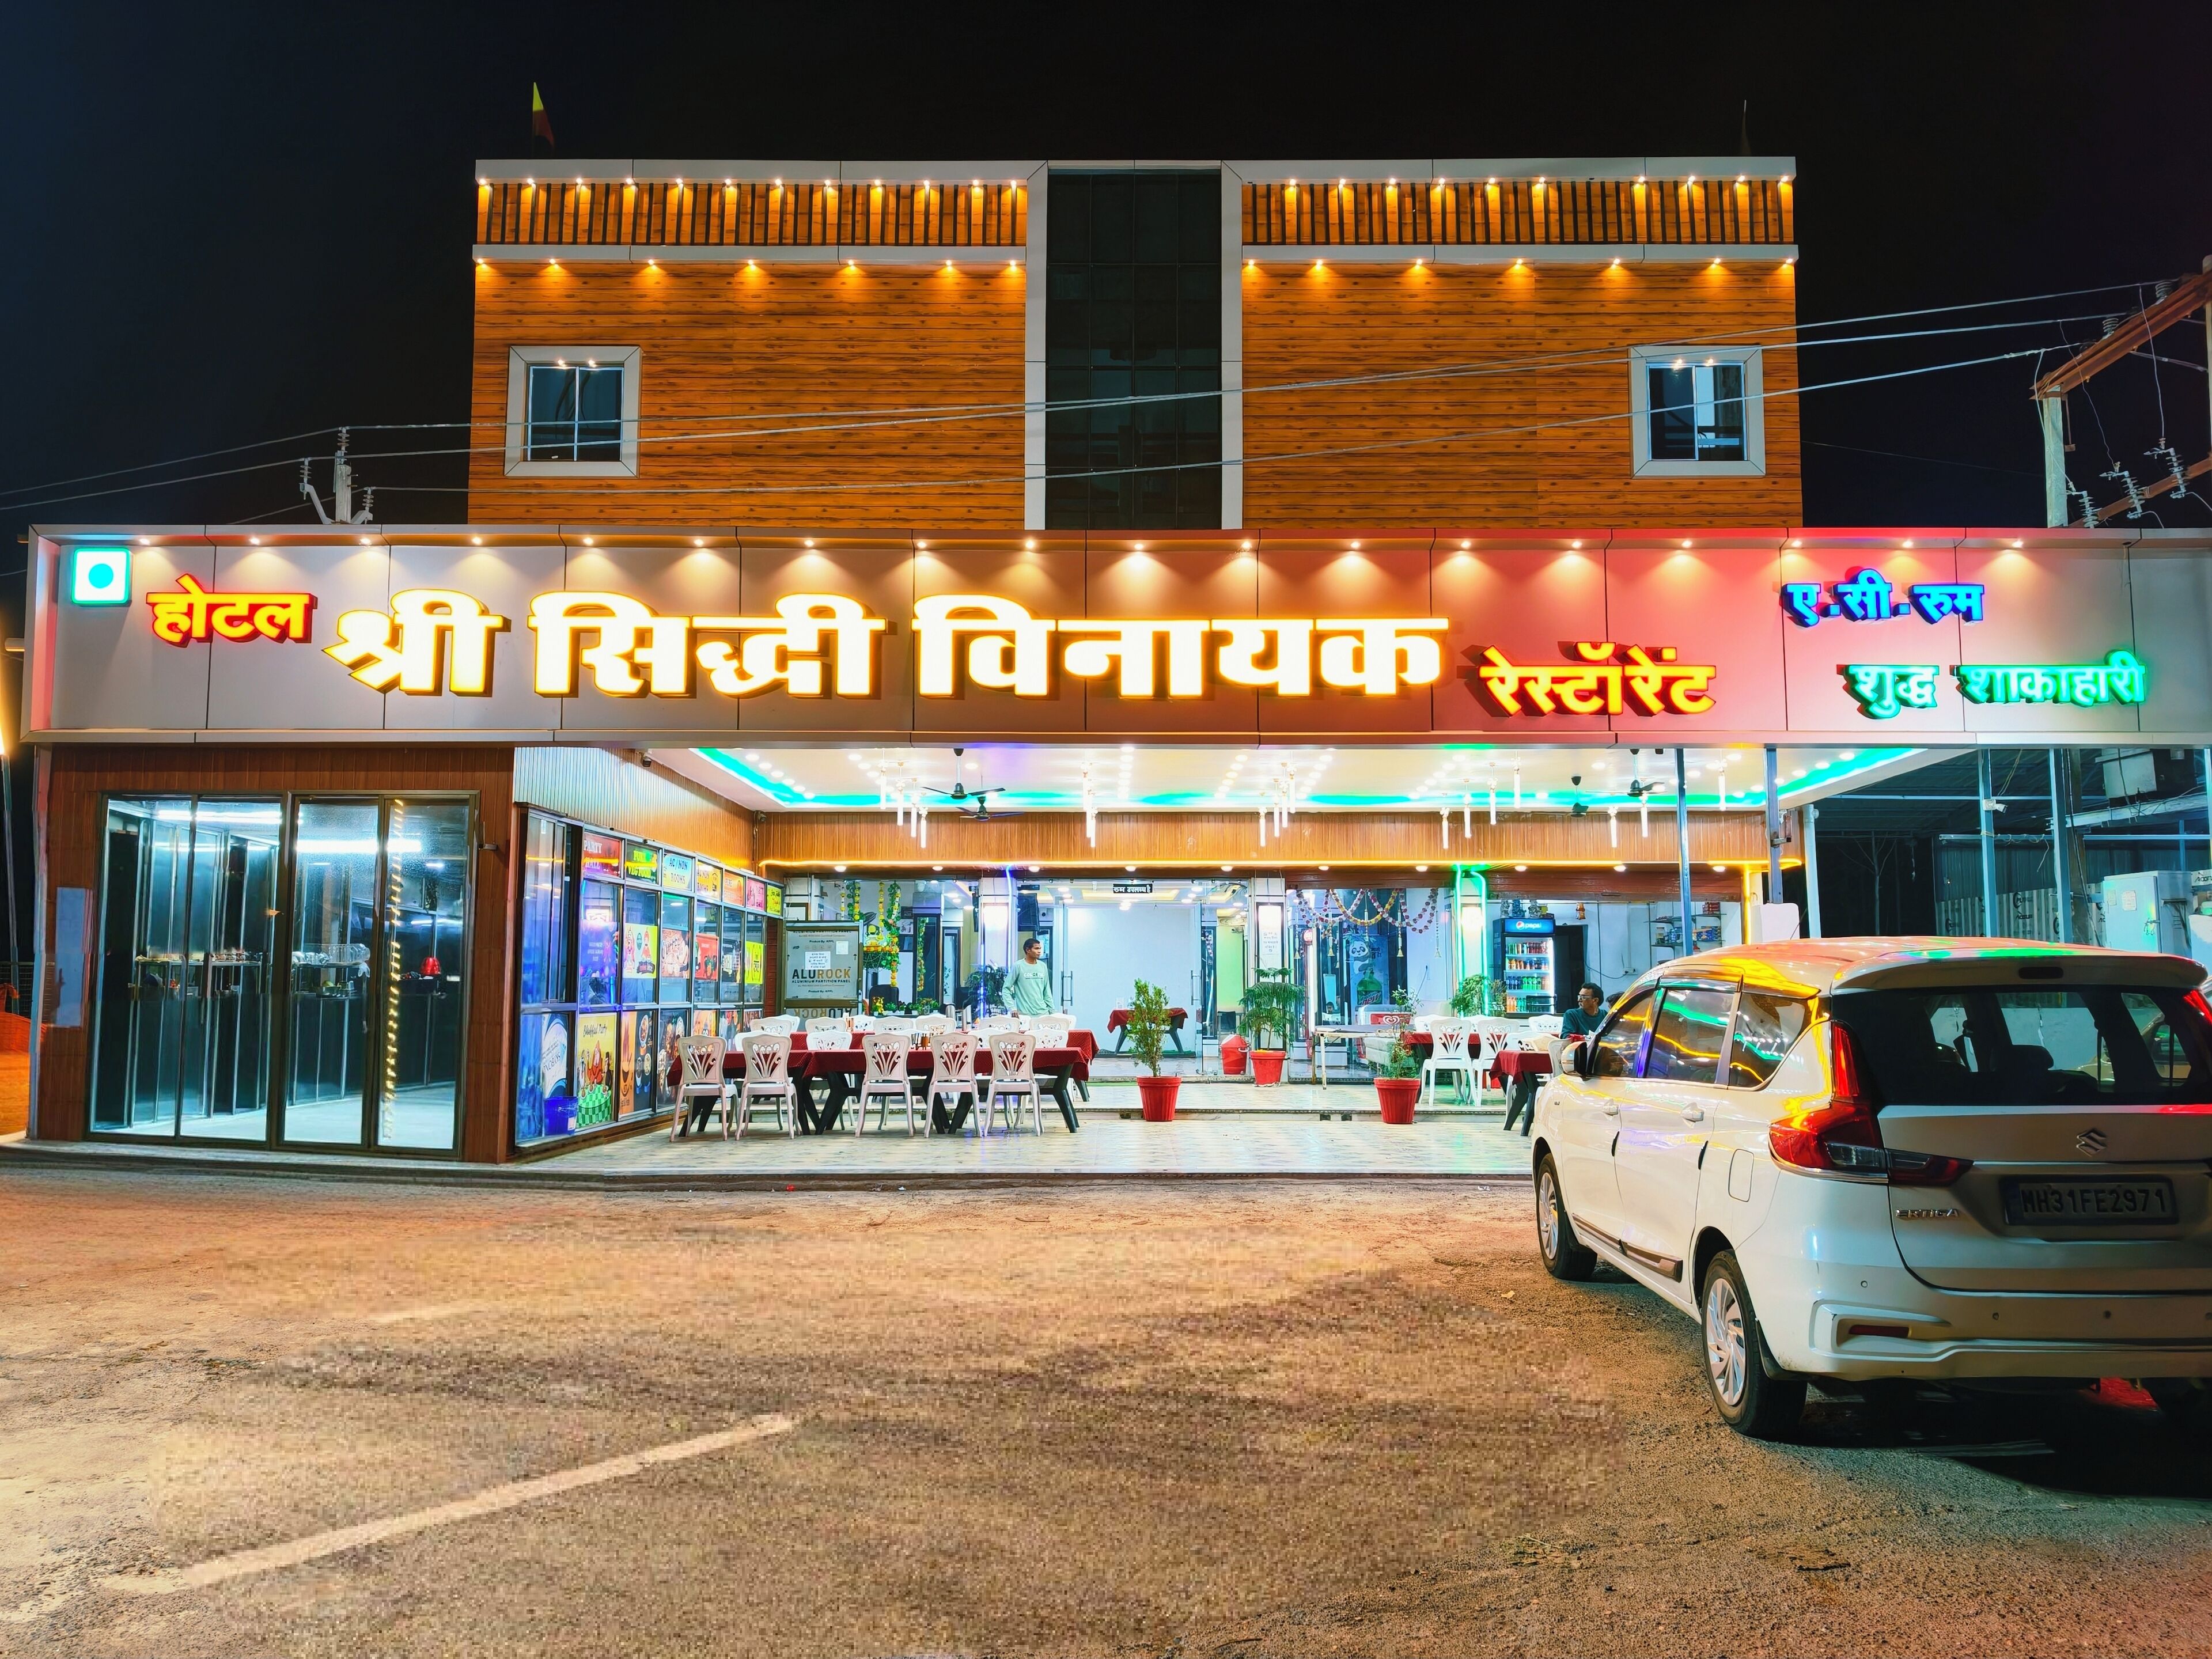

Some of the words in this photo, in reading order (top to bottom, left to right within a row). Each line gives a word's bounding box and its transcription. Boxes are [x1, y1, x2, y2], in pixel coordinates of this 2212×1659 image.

[146, 574, 317, 647] होटल
[322, 589, 506, 696] श्री
[911, 593, 1450, 698] विनायक
[1476, 641, 1717, 717] रेस्टॉरेंट
[1845, 664, 1940, 719] शुद्ध
[1957, 649, 2147, 705] शाकाहारी
[584, 840, 603, 854] PARTY
[671, 873, 685, 884] ROOMS
[792, 969, 851, 979] ALUROCK
[1896, 1209, 1959, 1218] ERTIGA
[2020, 1188, 2166, 1214] MH31FE2971
